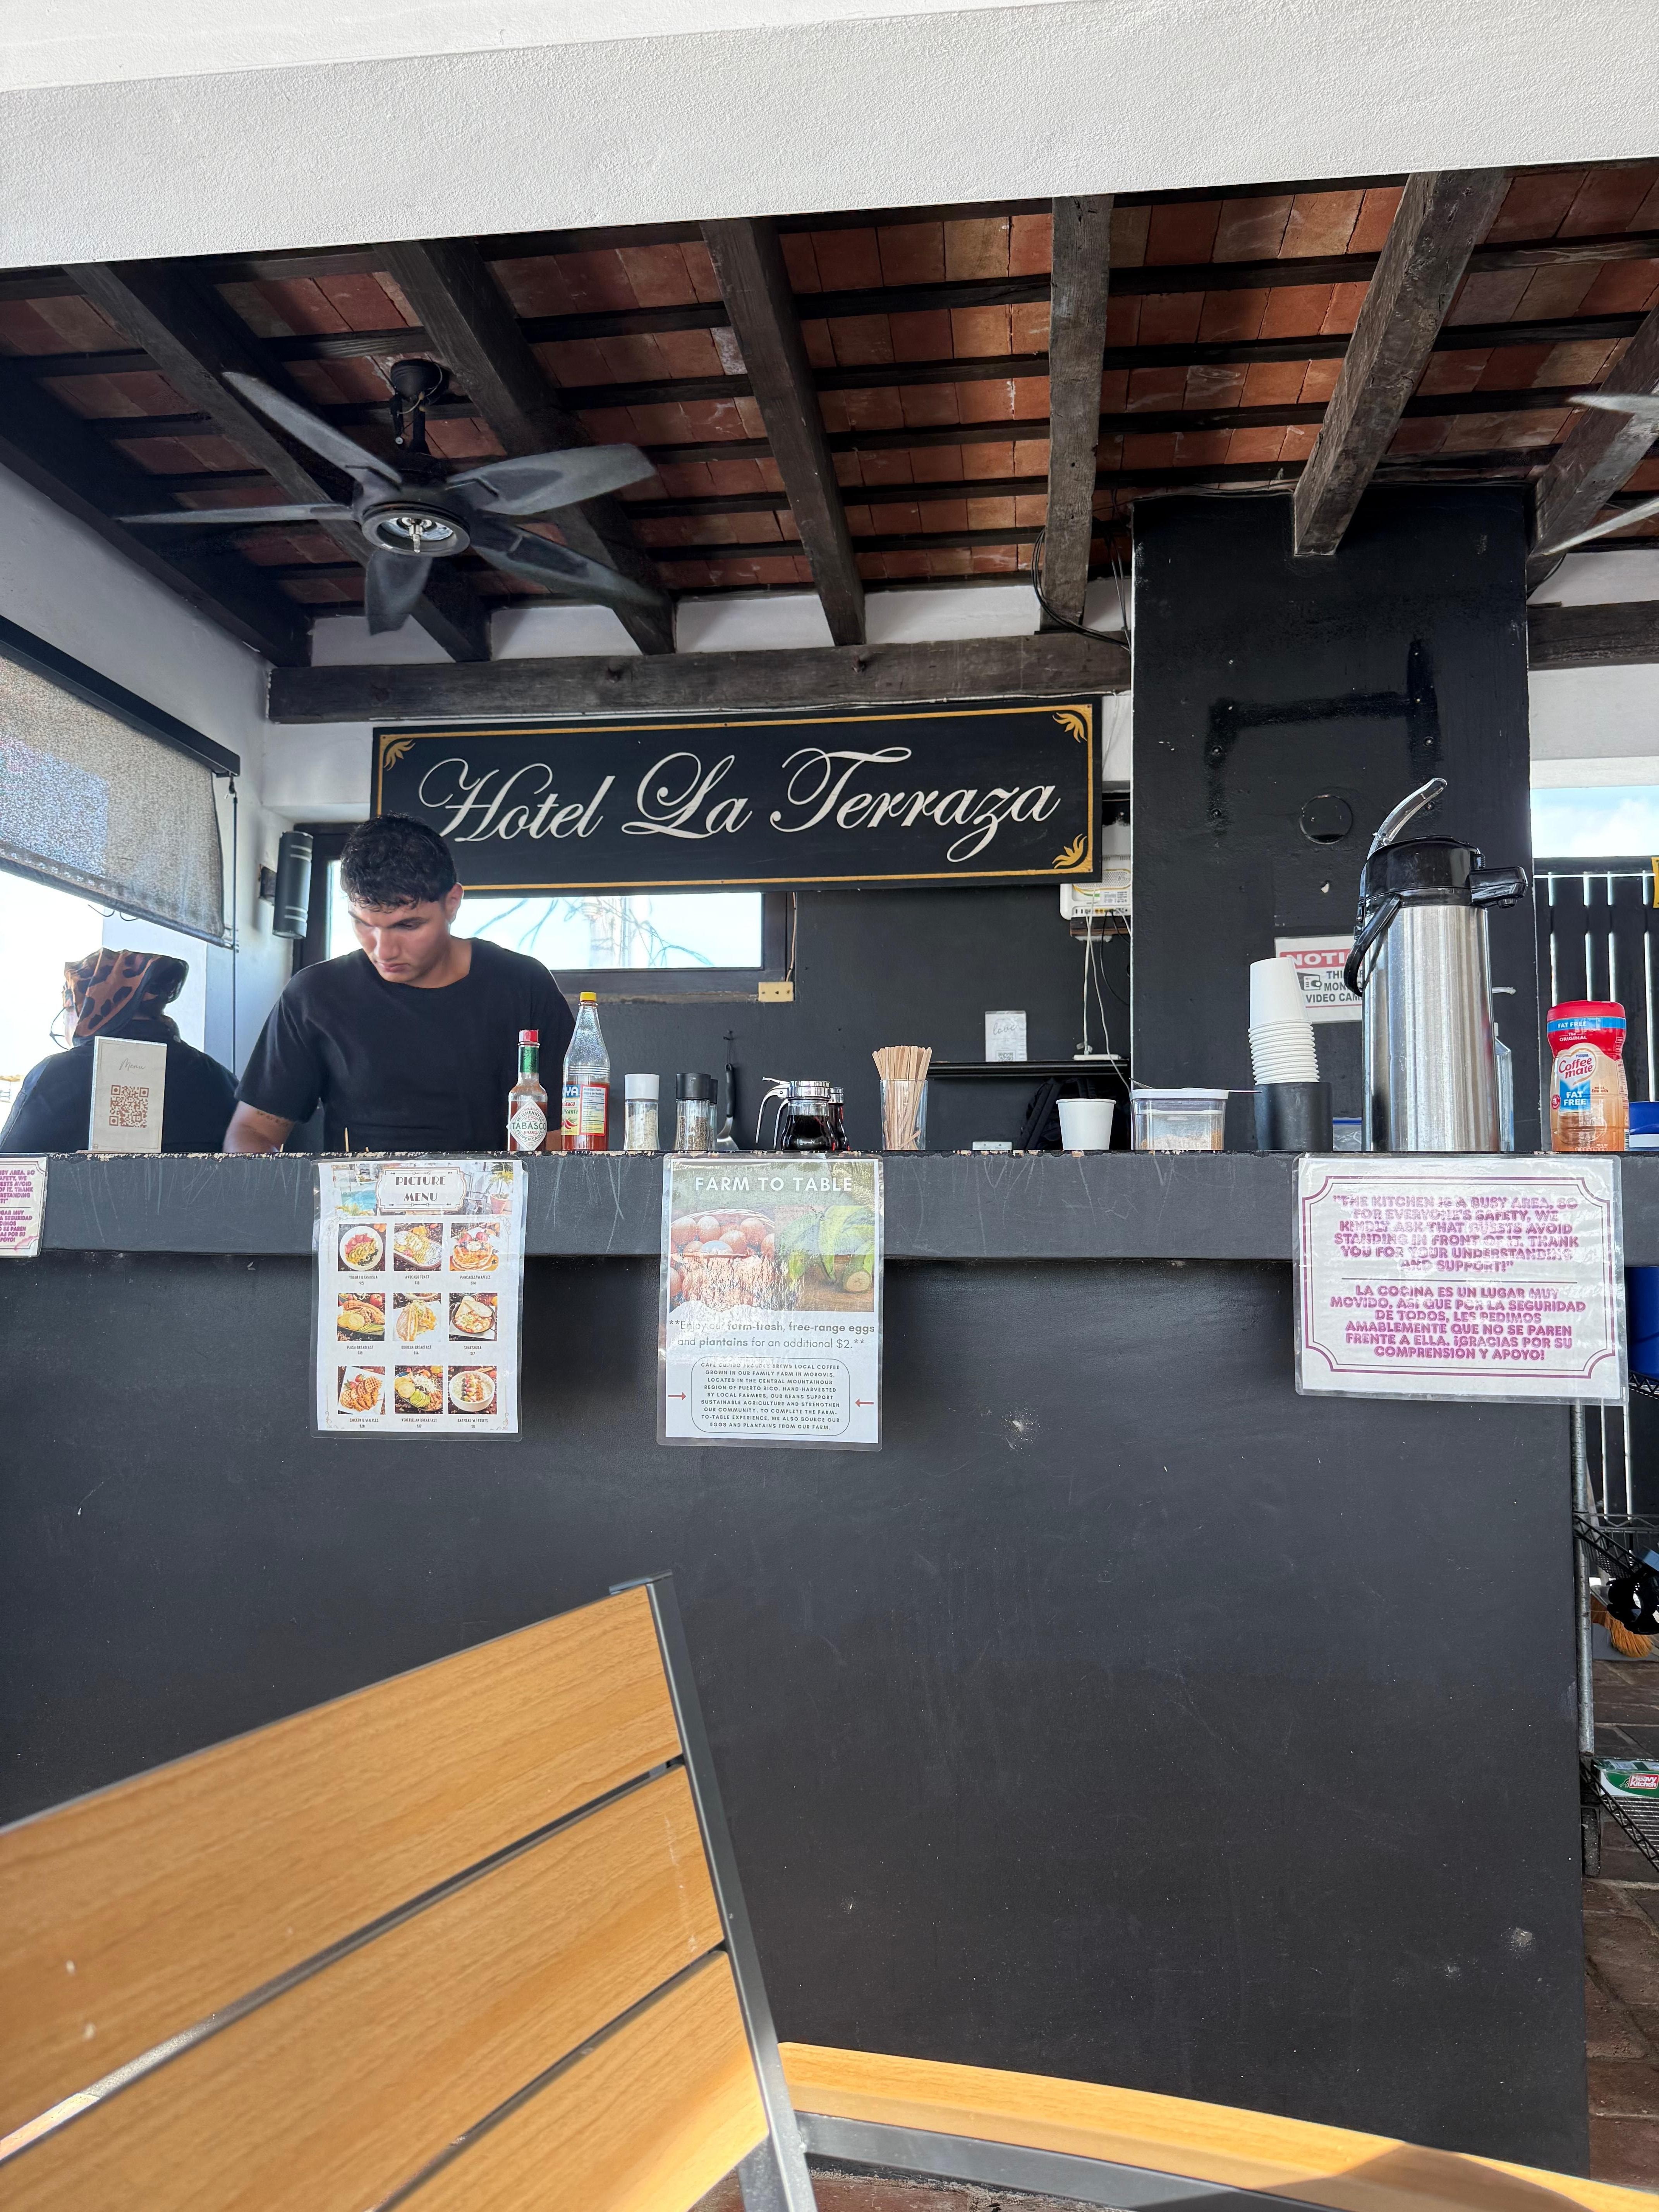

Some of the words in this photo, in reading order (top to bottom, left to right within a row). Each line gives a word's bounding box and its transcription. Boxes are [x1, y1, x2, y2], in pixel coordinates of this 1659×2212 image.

[419, 758, 615, 842] Hotel
[622, 752, 752, 839] La
[769, 746, 1061, 863] Terraza
[1286, 952, 1350, 966] NOTI
[1326, 970, 1343, 979] THI
[1306, 993, 1336, 1003] VIDEO
[119, 1058, 146, 1071] Menu
[1559, 1058, 1592, 1073] Coffee
[1565, 1065, 1593, 1079] mate
[517, 1130, 531, 1141] PEPPER
[532, 1130, 544, 1141] SAUCE
[395, 1176, 446, 1185] PICTURE
[695, 1176, 750, 1192] FARM
[758, 1176, 784, 1192] TO
[792, 1176, 853, 1192] TABLE
[404, 1192, 438, 1201] MENU
[1372, 1196, 1434, 1207] KITCHEN
[1470, 1197, 1508, 1208] BUSY
[1511, 1197, 1554, 1210] AREA,
[1354, 1209, 1382, 1219] FOR
[1475, 1210, 1531, 1222] SAFETY,
[1535, 1210, 1559, 1221] WE
[1394, 1222, 1424, 1232] ASK
[1426, 1222, 1465, 1233] THAT
[1525, 1223, 1572, 1235] AVOID
[1334, 1233, 1408, 1244] STANDING
[1432, 1235, 1480, 1246] FRONT
[1528, 1236, 1579, 1247] THANK
[1341, 1245, 1372, 1257] YOU
[1376, 1246, 1403, 1257] FOR
[1408, 1247, 1448, 1259] YOUR
[1356, 1285, 1374, 1297] LA
[1377, 1286, 1434, 1297] COCINA
[1437, 1287, 1453, 1297] ES
[1457, 1287, 1477, 1298] UN
[1480, 1288, 1525, 1298] LUGAR
[1529, 1288, 1558, 1299] MUY
[1330, 1297, 1393, 1311] MOVIDO,
[1423, 1298, 1451, 1310] QUE
[1455, 1299, 1484, 1311] POR
[1487, 1300, 1505, 1310] LA
[1508, 1300, 1586, 1312] SEGURIDAD
[1376, 1310, 1394, 1321] DE
[1397, 1310, 1449, 1322] TODOS,
[1454, 1311, 1476, 1322] LES
[1480, 1312, 1541, 1323] PEDIMOS
[789, 1321, 845, 1334] free-range
[848, 1325, 875, 1335] eggs
[1345, 1322, 1448, 1334] AMABLEMENTE
[1451, 1324, 1479, 1334] QUE
[1483, 1324, 1503, 1335] NO
[1508, 1325, 1523, 1335] SE
[1527, 1325, 1571, 1336] PAREN
[678, 1337, 696, 1346] and
[699, 1338, 748, 1348] plantains
[752, 1337, 765, 1346] for
[783, 1338, 833, 1348] additional
[1346, 1333, 1396, 1345] FRENTE
[1399, 1334, 1410, 1345] A
[1414, 1335, 1450, 1346] ELLA.
[1522, 1337, 1550, 1348] POR
[1554, 1338, 1572, 1349] SU
[1479, 1348, 1488, 1359] Y
[1492, 1349, 1544, 1360] APOYO!
